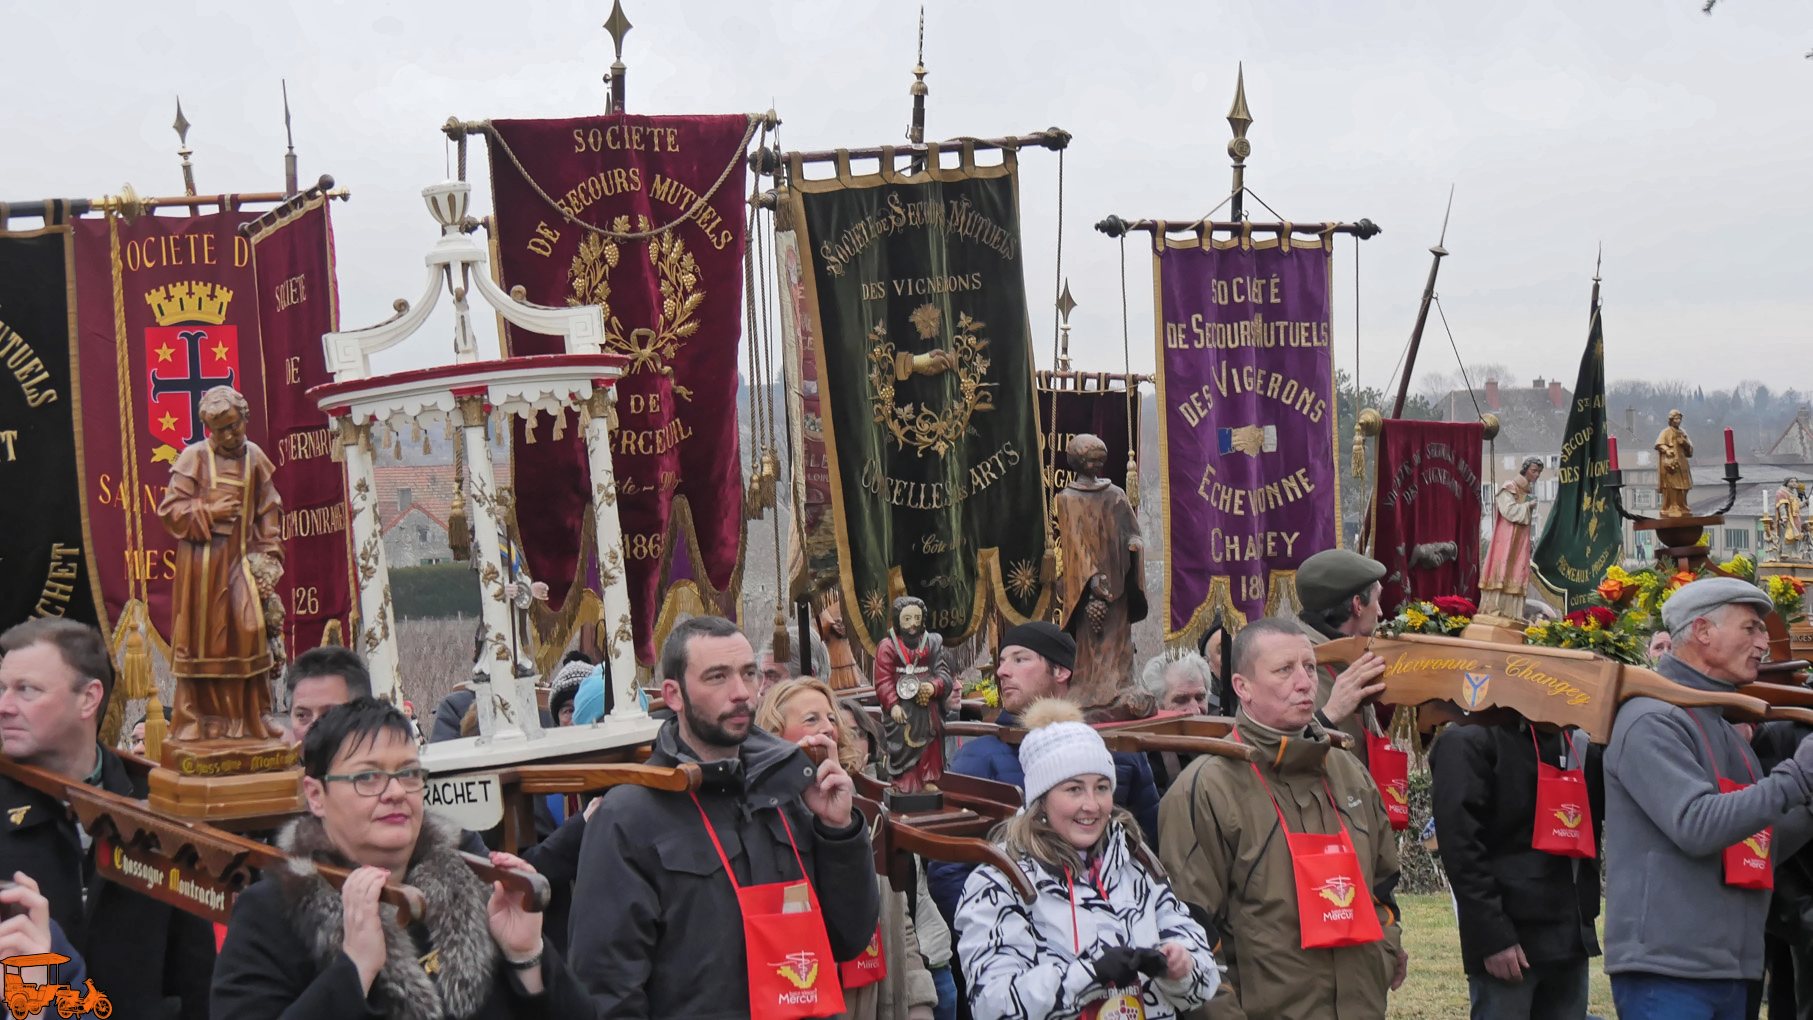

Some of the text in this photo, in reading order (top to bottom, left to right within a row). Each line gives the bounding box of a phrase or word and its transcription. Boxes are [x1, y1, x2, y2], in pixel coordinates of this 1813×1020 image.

[527, 168, 733, 258] DE SECOURS MUTUELS
[862, 281, 886, 301] DES
[1166, 321, 1190, 350] DE
[1252, 312, 1329, 349] MUTUELS
[286, 356, 301, 386] DE
[630, 393, 660, 414] DE
[1178, 384, 1215, 428] DES
[969, 440, 1021, 495] ARTS
[1560, 465, 1580, 484] DES
[28, 542, 80, 621] CHET
[1383, 651, 1479, 679] chevronne
[1504, 654, 1591, 705] Changey
[169, 868, 226, 911] Montrachet
